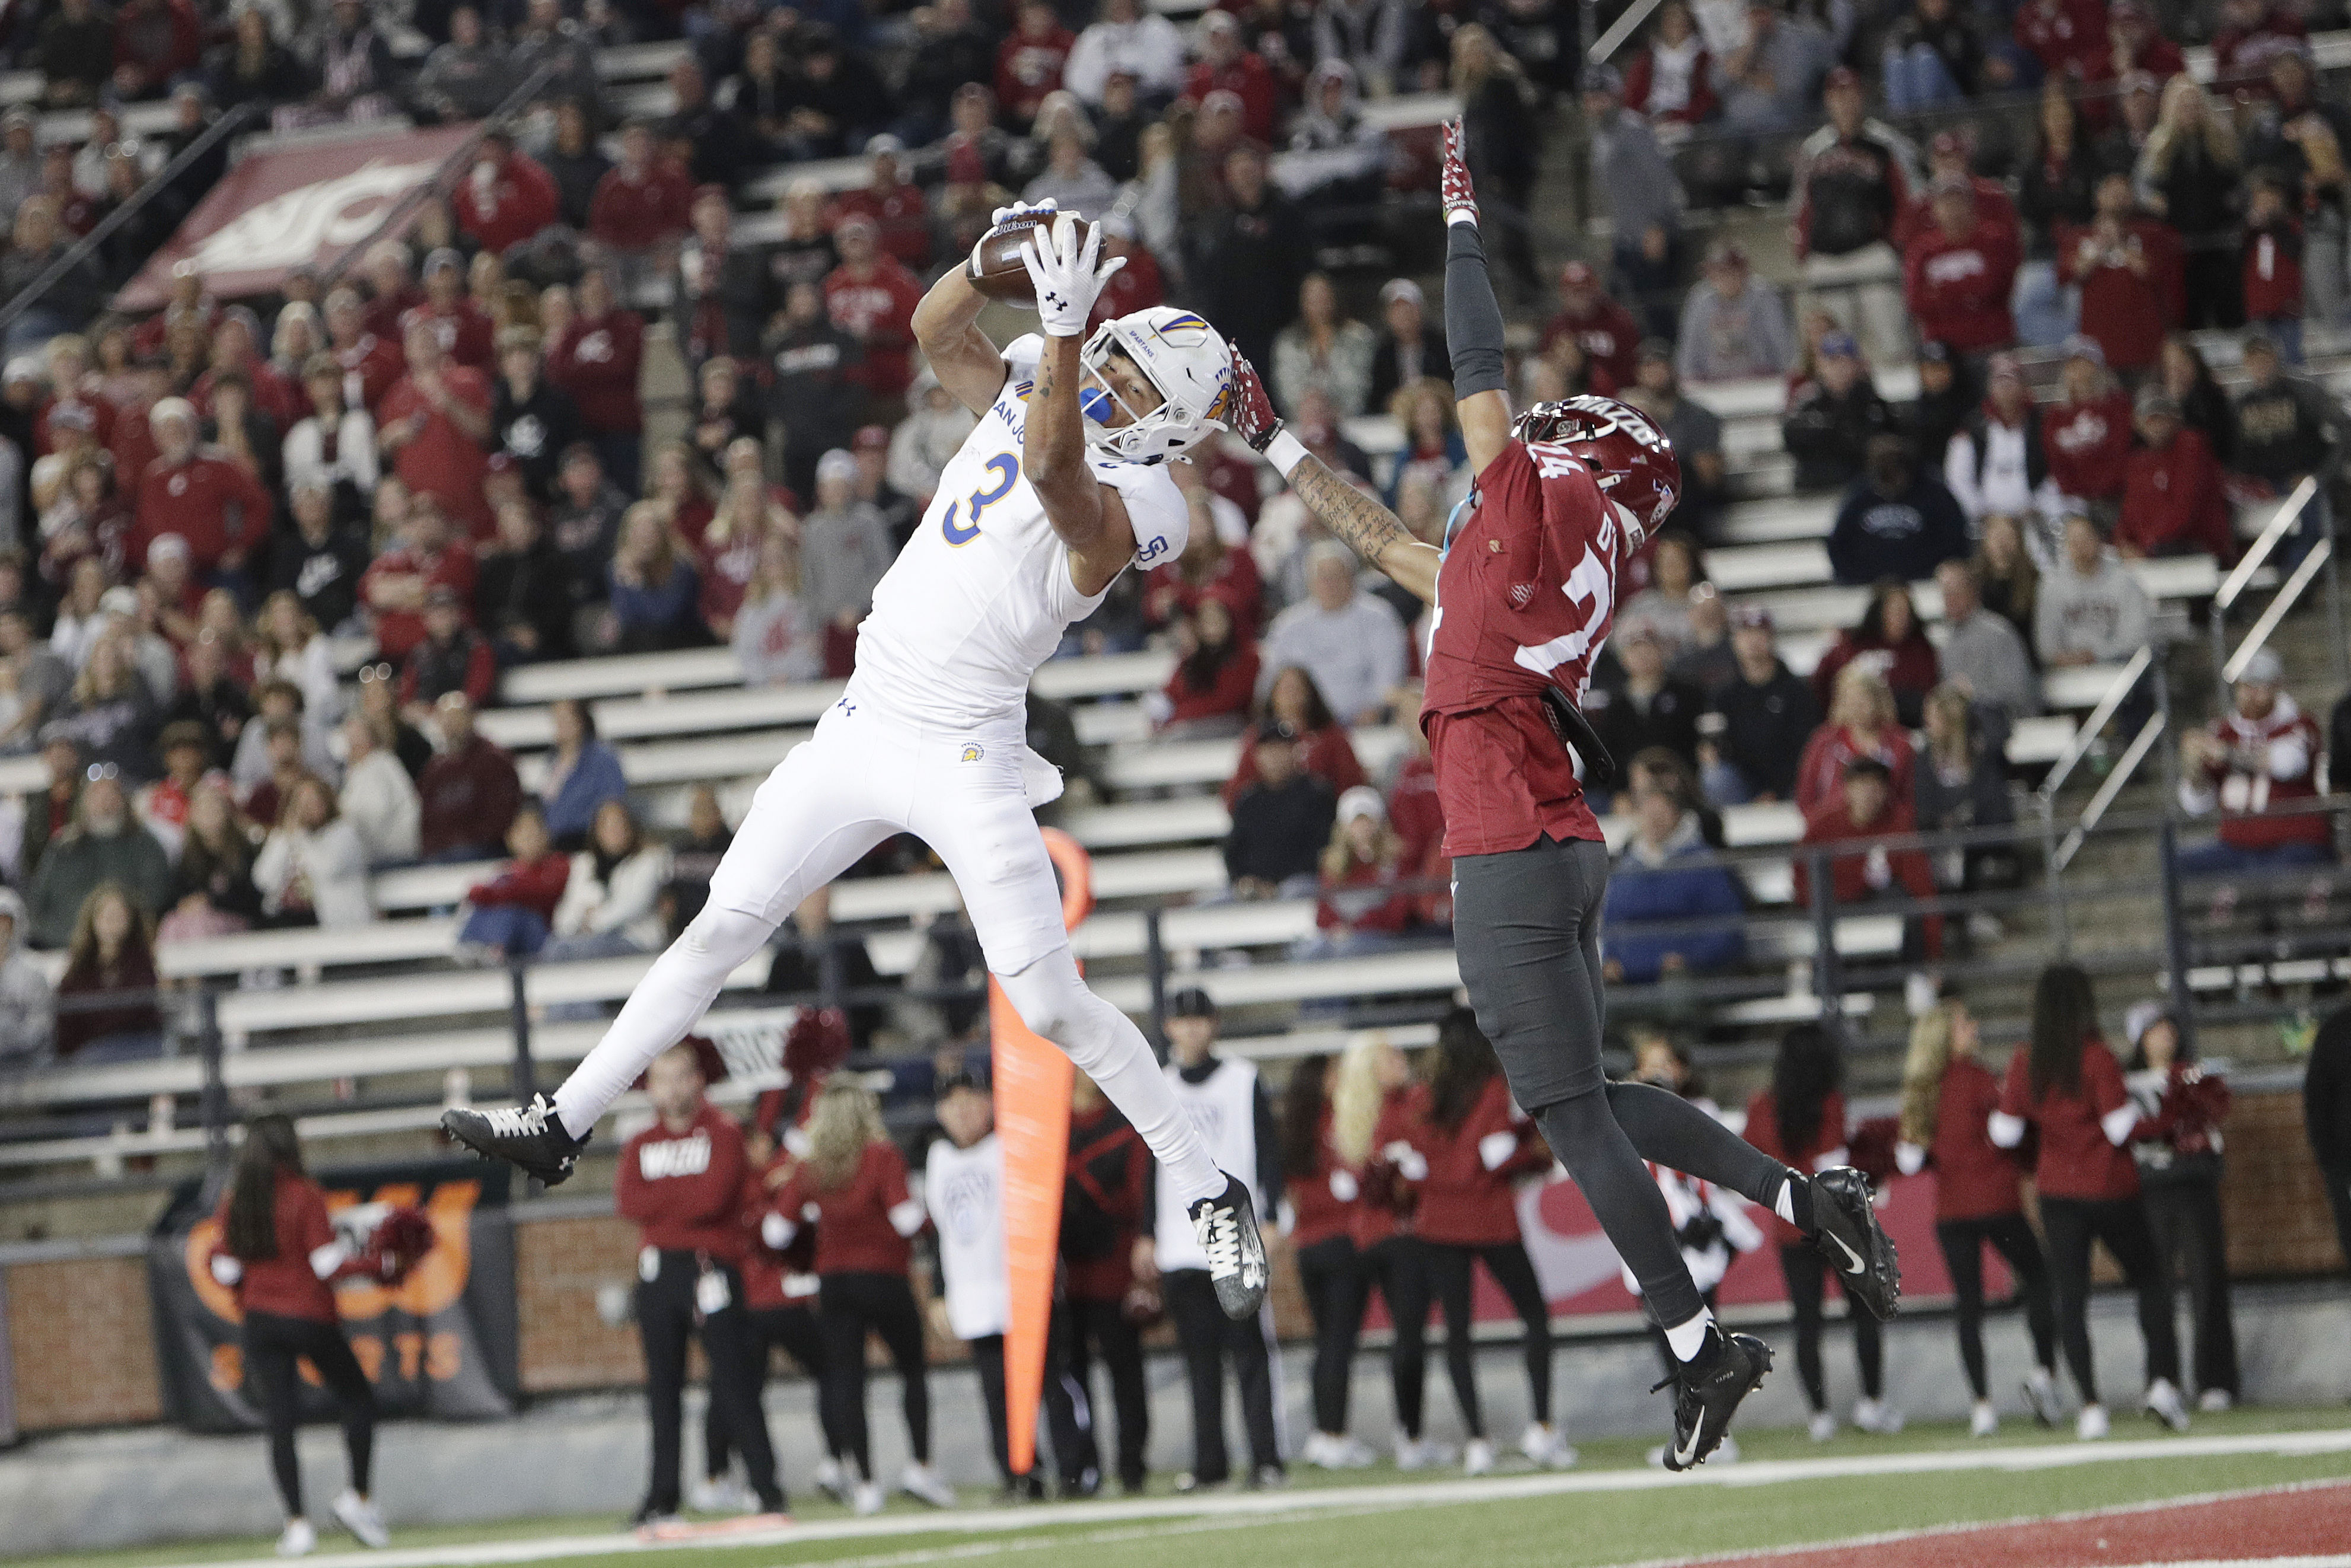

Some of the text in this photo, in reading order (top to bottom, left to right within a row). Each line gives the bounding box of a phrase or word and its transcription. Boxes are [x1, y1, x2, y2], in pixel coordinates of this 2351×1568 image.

[1129, 330, 1155, 357] SPARTANS
[941, 450, 1022, 549] 3
[1514, 540, 1612, 714] 2
[1715, 1371, 1734, 1384] VAPOR
